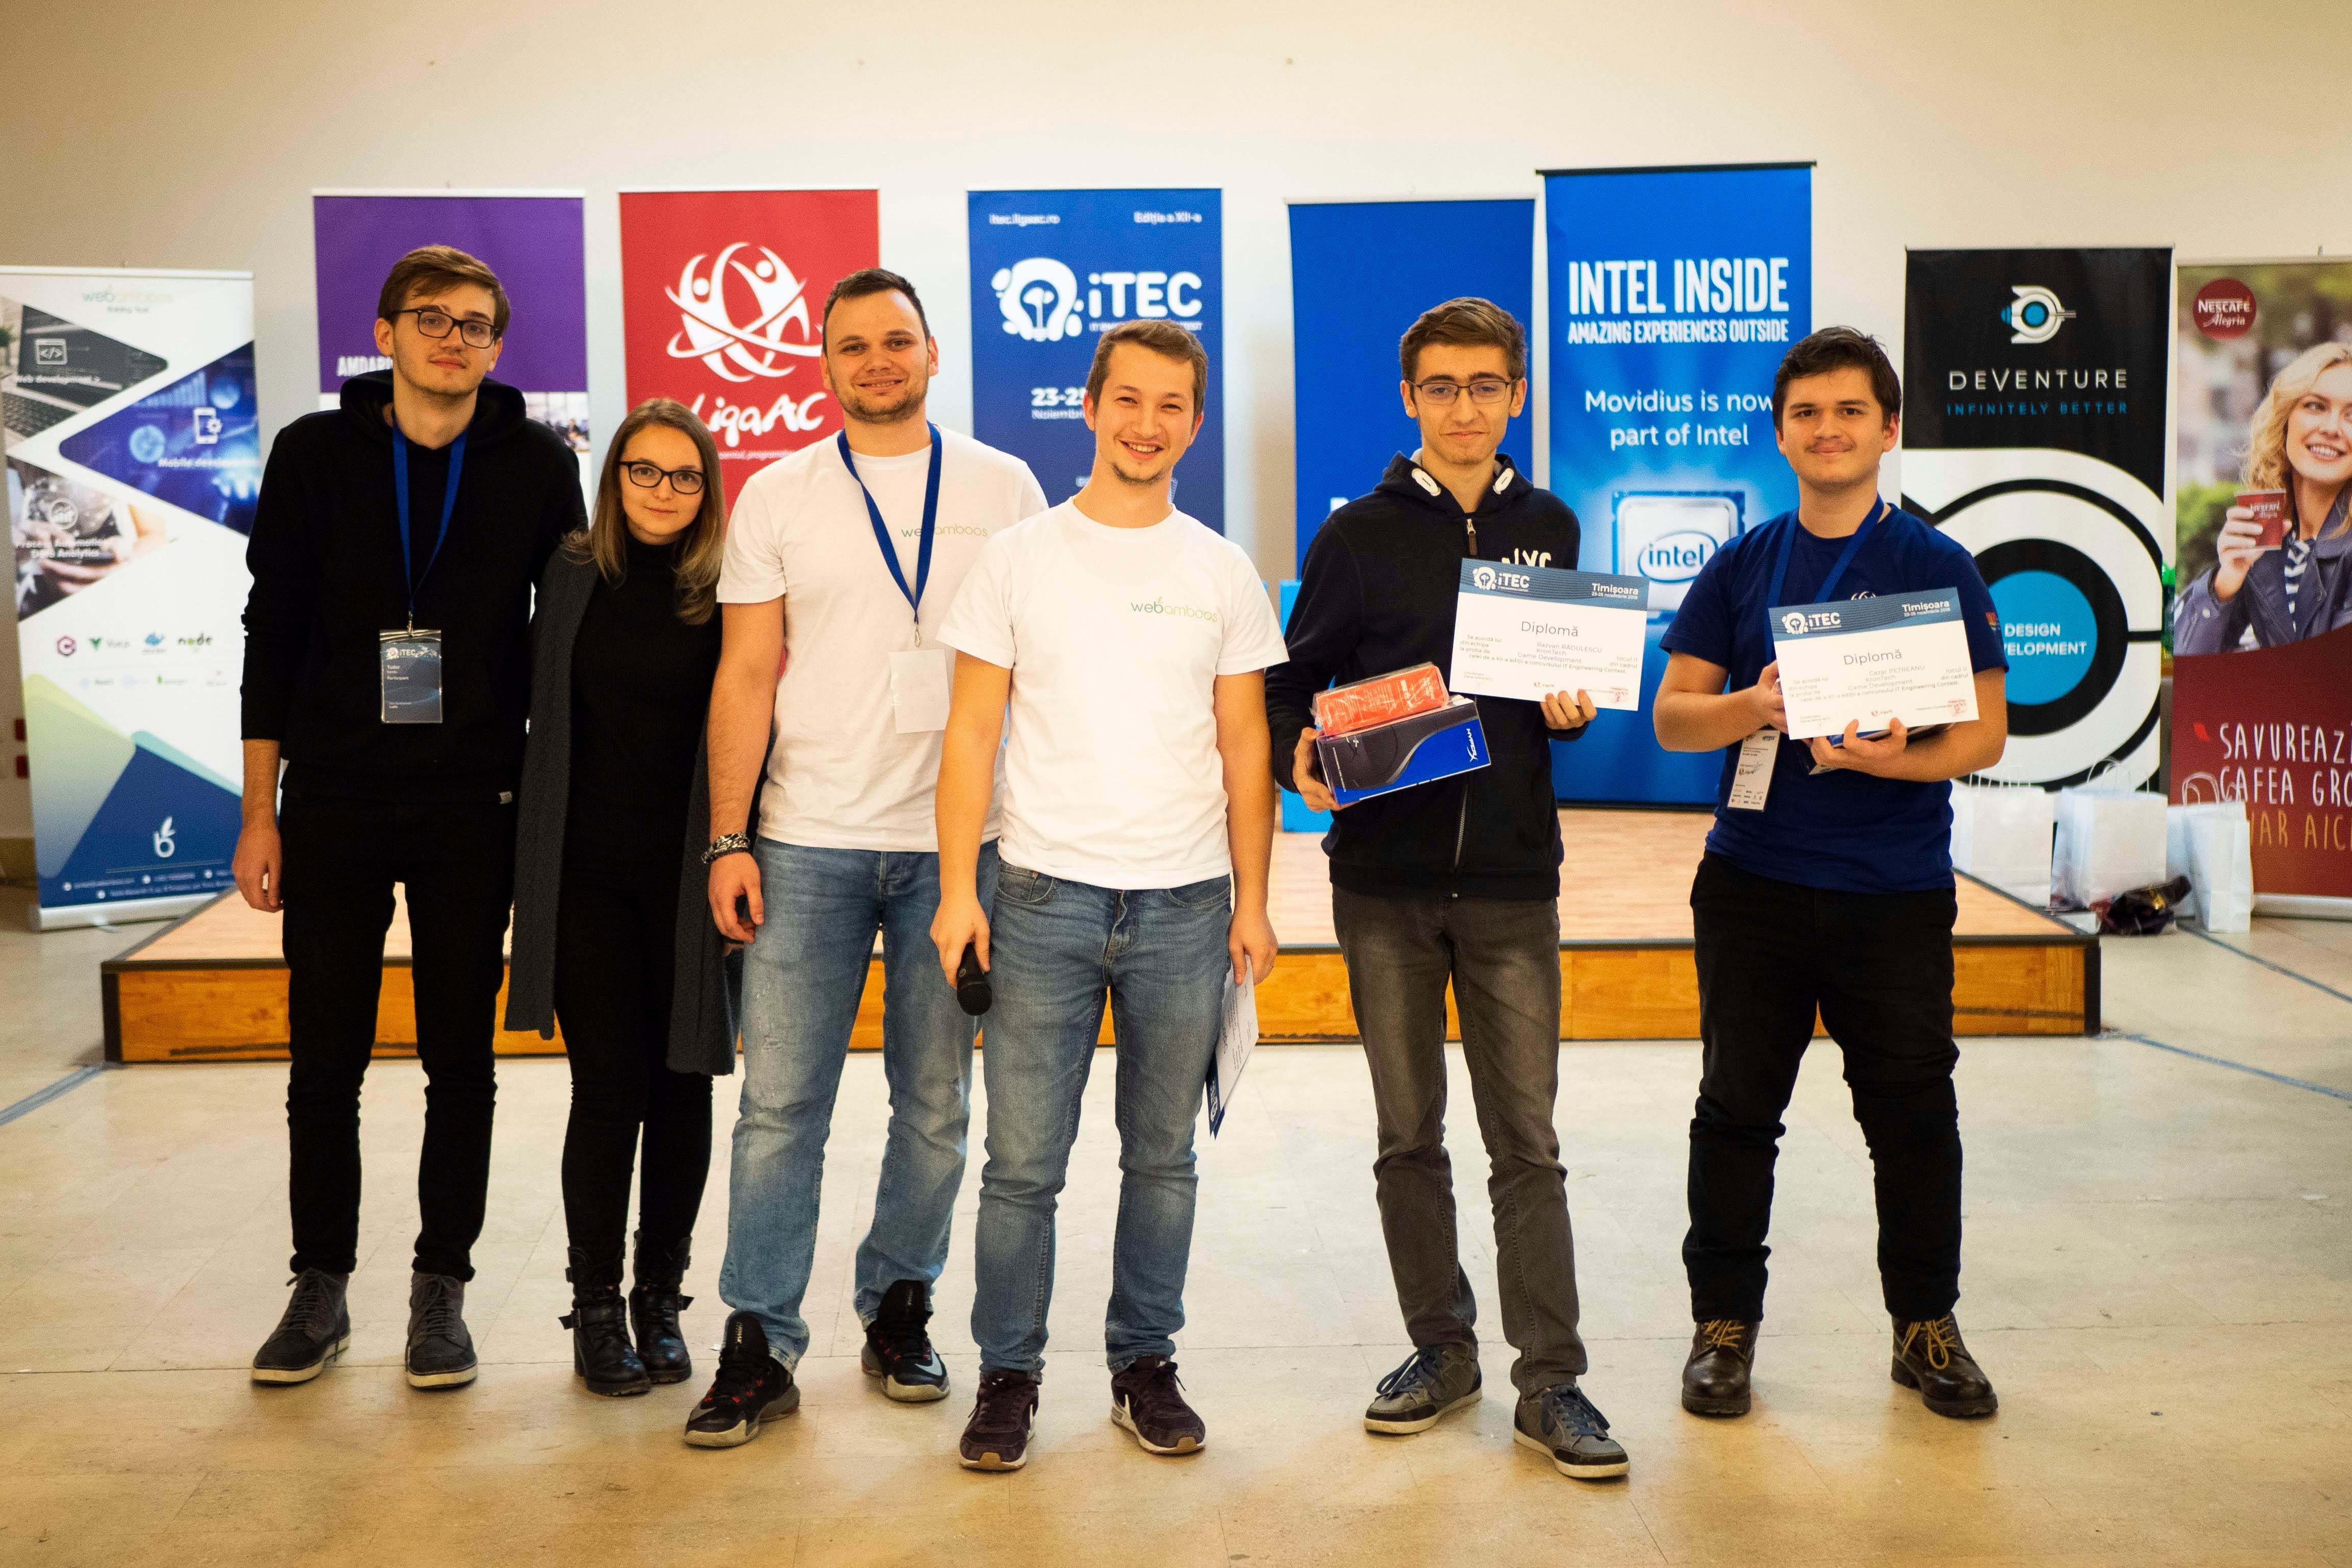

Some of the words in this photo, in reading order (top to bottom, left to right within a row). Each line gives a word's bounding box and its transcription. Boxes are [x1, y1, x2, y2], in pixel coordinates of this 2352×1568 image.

[1569, 260, 1666, 314] INTEL
[1674, 257, 1789, 313] INSIDE
[1089, 272, 1203, 318] iTEC
[1568, 321, 1631, 344] AMAZING
[1634, 320, 1727, 343] EXPERIENCES
[1729, 318, 1789, 342] OUTSIDE
[1949, 369, 2127, 392] DEVENTURE
[1585, 389, 1693, 412] Movidius
[1701, 389, 1719, 412] is
[1947, 402, 2048, 415] INFINITELY
[2060, 401, 2127, 414] BETTER
[1610, 427, 1658, 451] part
[1665, 423, 1690, 446] of
[1697, 423, 1749, 446] Intel
[901, 523, 988, 538] weamboos
[1649, 543, 1705, 568] intel
[1498, 572, 1530, 589] iTEC
[1131, 598, 1218, 622] webamboos
[1808, 612, 1841, 627] iTEC
[1521, 621, 1579, 637] Diplomă
[2004, 623, 2061, 638] DESIGN
[1536, 648, 1567, 656] KronTech
[2004, 641, 2087, 656] ELOPMENT
[1538, 653, 1582, 664] Development
[1844, 649, 1902, 665] Diplomă
[1569, 664, 1603, 673] Engineering
[1869, 679, 1913, 689] Development
[1901, 682, 1936, 692] Engineering
[1466, 728, 1478, 763] HYPERX
[2219, 722, 2352, 765] SAVUREAZ
